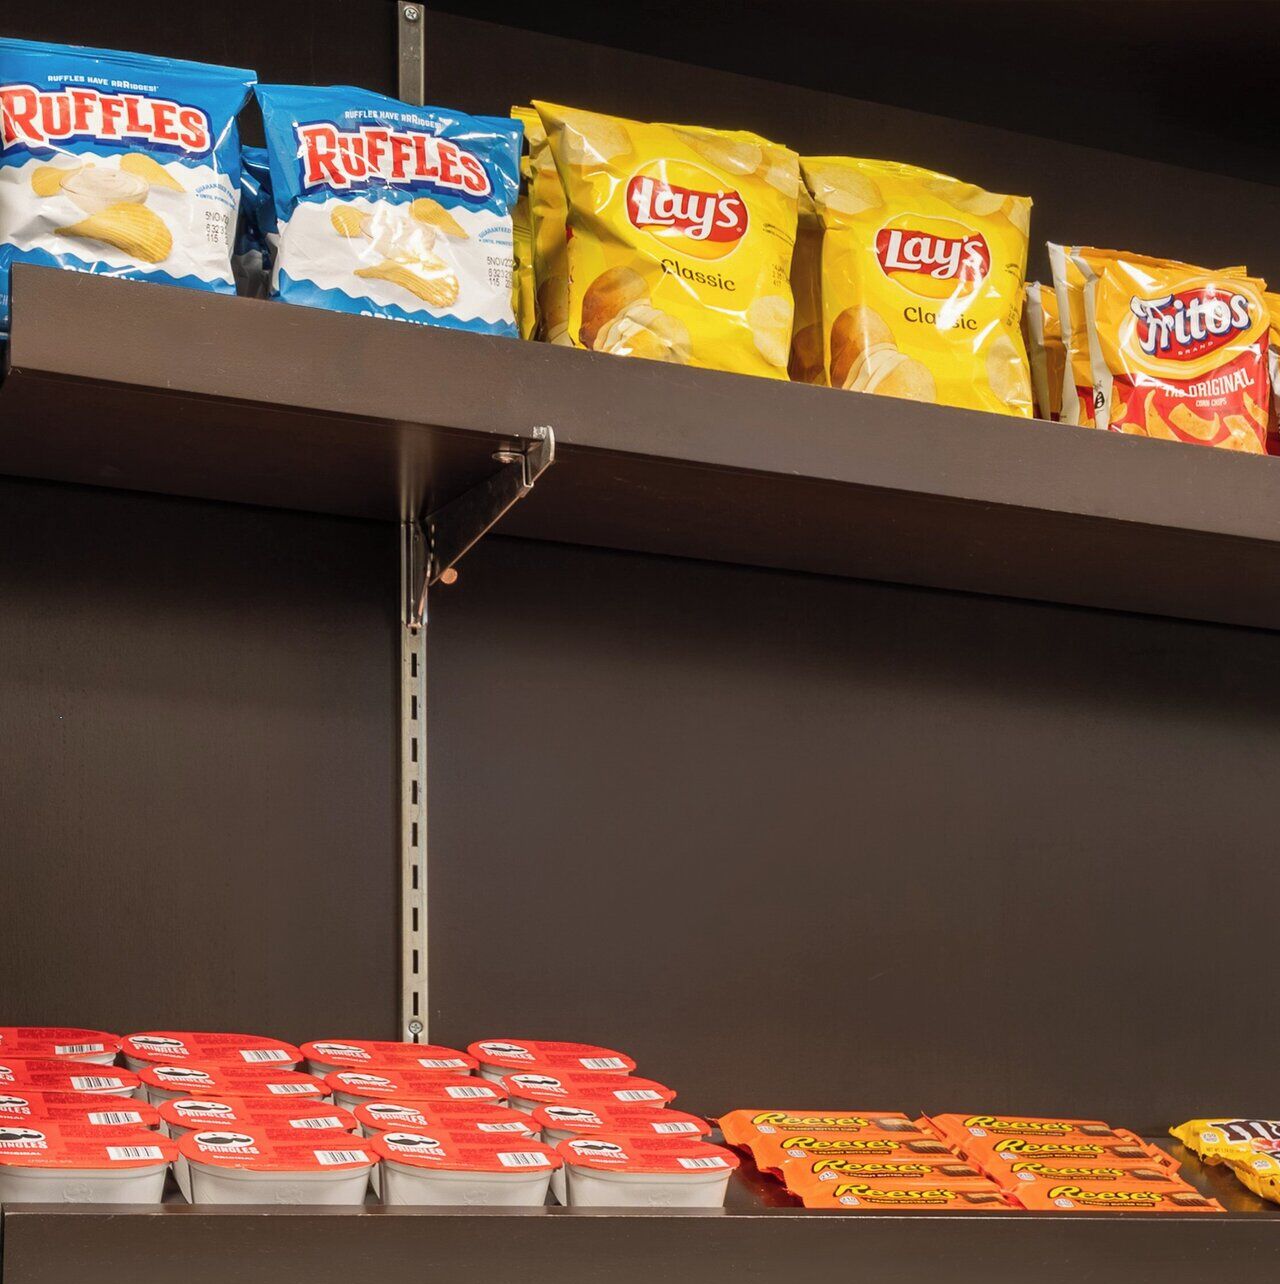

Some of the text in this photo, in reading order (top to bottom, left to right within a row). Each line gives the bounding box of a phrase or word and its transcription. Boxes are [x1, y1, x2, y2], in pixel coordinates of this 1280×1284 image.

[47, 75, 109, 86] RUFFLES HAVE
[0, 87, 209, 149] RUFFLES
[344, 110, 399, 121] RUFFLES HAVE
[302, 127, 488, 192] RUFFLES
[632, 173, 742, 240] Lay's
[887, 230, 987, 280] Lay's
[661, 258, 737, 293] Classic
[903, 306, 979, 332] Clasic
[1129, 293, 1252, 356] Fritos
[1177, 341, 1214, 356] BRAND
[1188, 367, 1255, 398] ORIGINAL
[1195, 397, 1228, 408] CORN CHIPS
[134, 1043, 190, 1056] PRINGLES
[177, 1109, 237, 1121] PRINGLES
[371, 1112, 429, 1126] PRINGLES
[751, 1111, 871, 1128] Reese's
[963, 1115, 1075, 1132] Reese's
[198, 1143, 260, 1156] PRINGLES
[387, 1143, 447, 1157] PRINGLES
[780, 1135, 902, 1150] Reese's
[993, 1137, 1107, 1155] Reese's
[574, 1148, 630, 1160] PRINGLES
[811, 1158, 934, 1174] Reese's
[1010, 1161, 1126, 1178] Reese's
[833, 1183, 958, 1200] Reese's
[1047, 1185, 1164, 1203] Reese's
